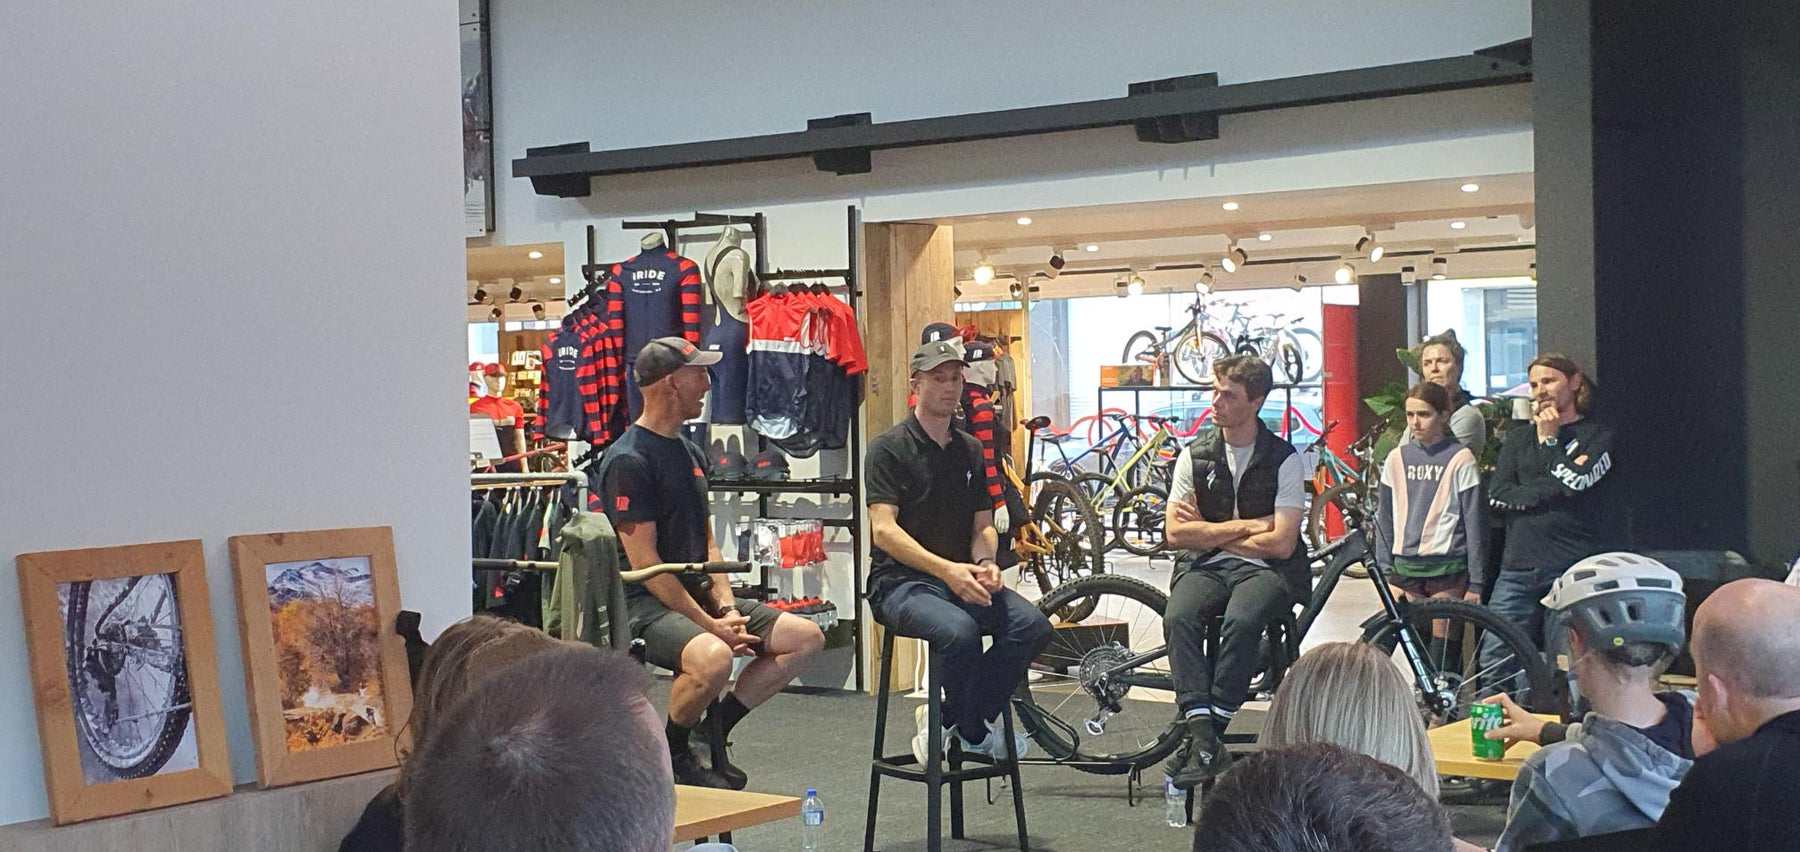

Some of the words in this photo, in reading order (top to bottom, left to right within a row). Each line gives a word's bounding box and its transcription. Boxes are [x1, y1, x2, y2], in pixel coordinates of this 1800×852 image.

[632, 269, 666, 281] IRIDE
[558, 346, 578, 358] IRIDE
[1407, 465, 1444, 481] ROXY
